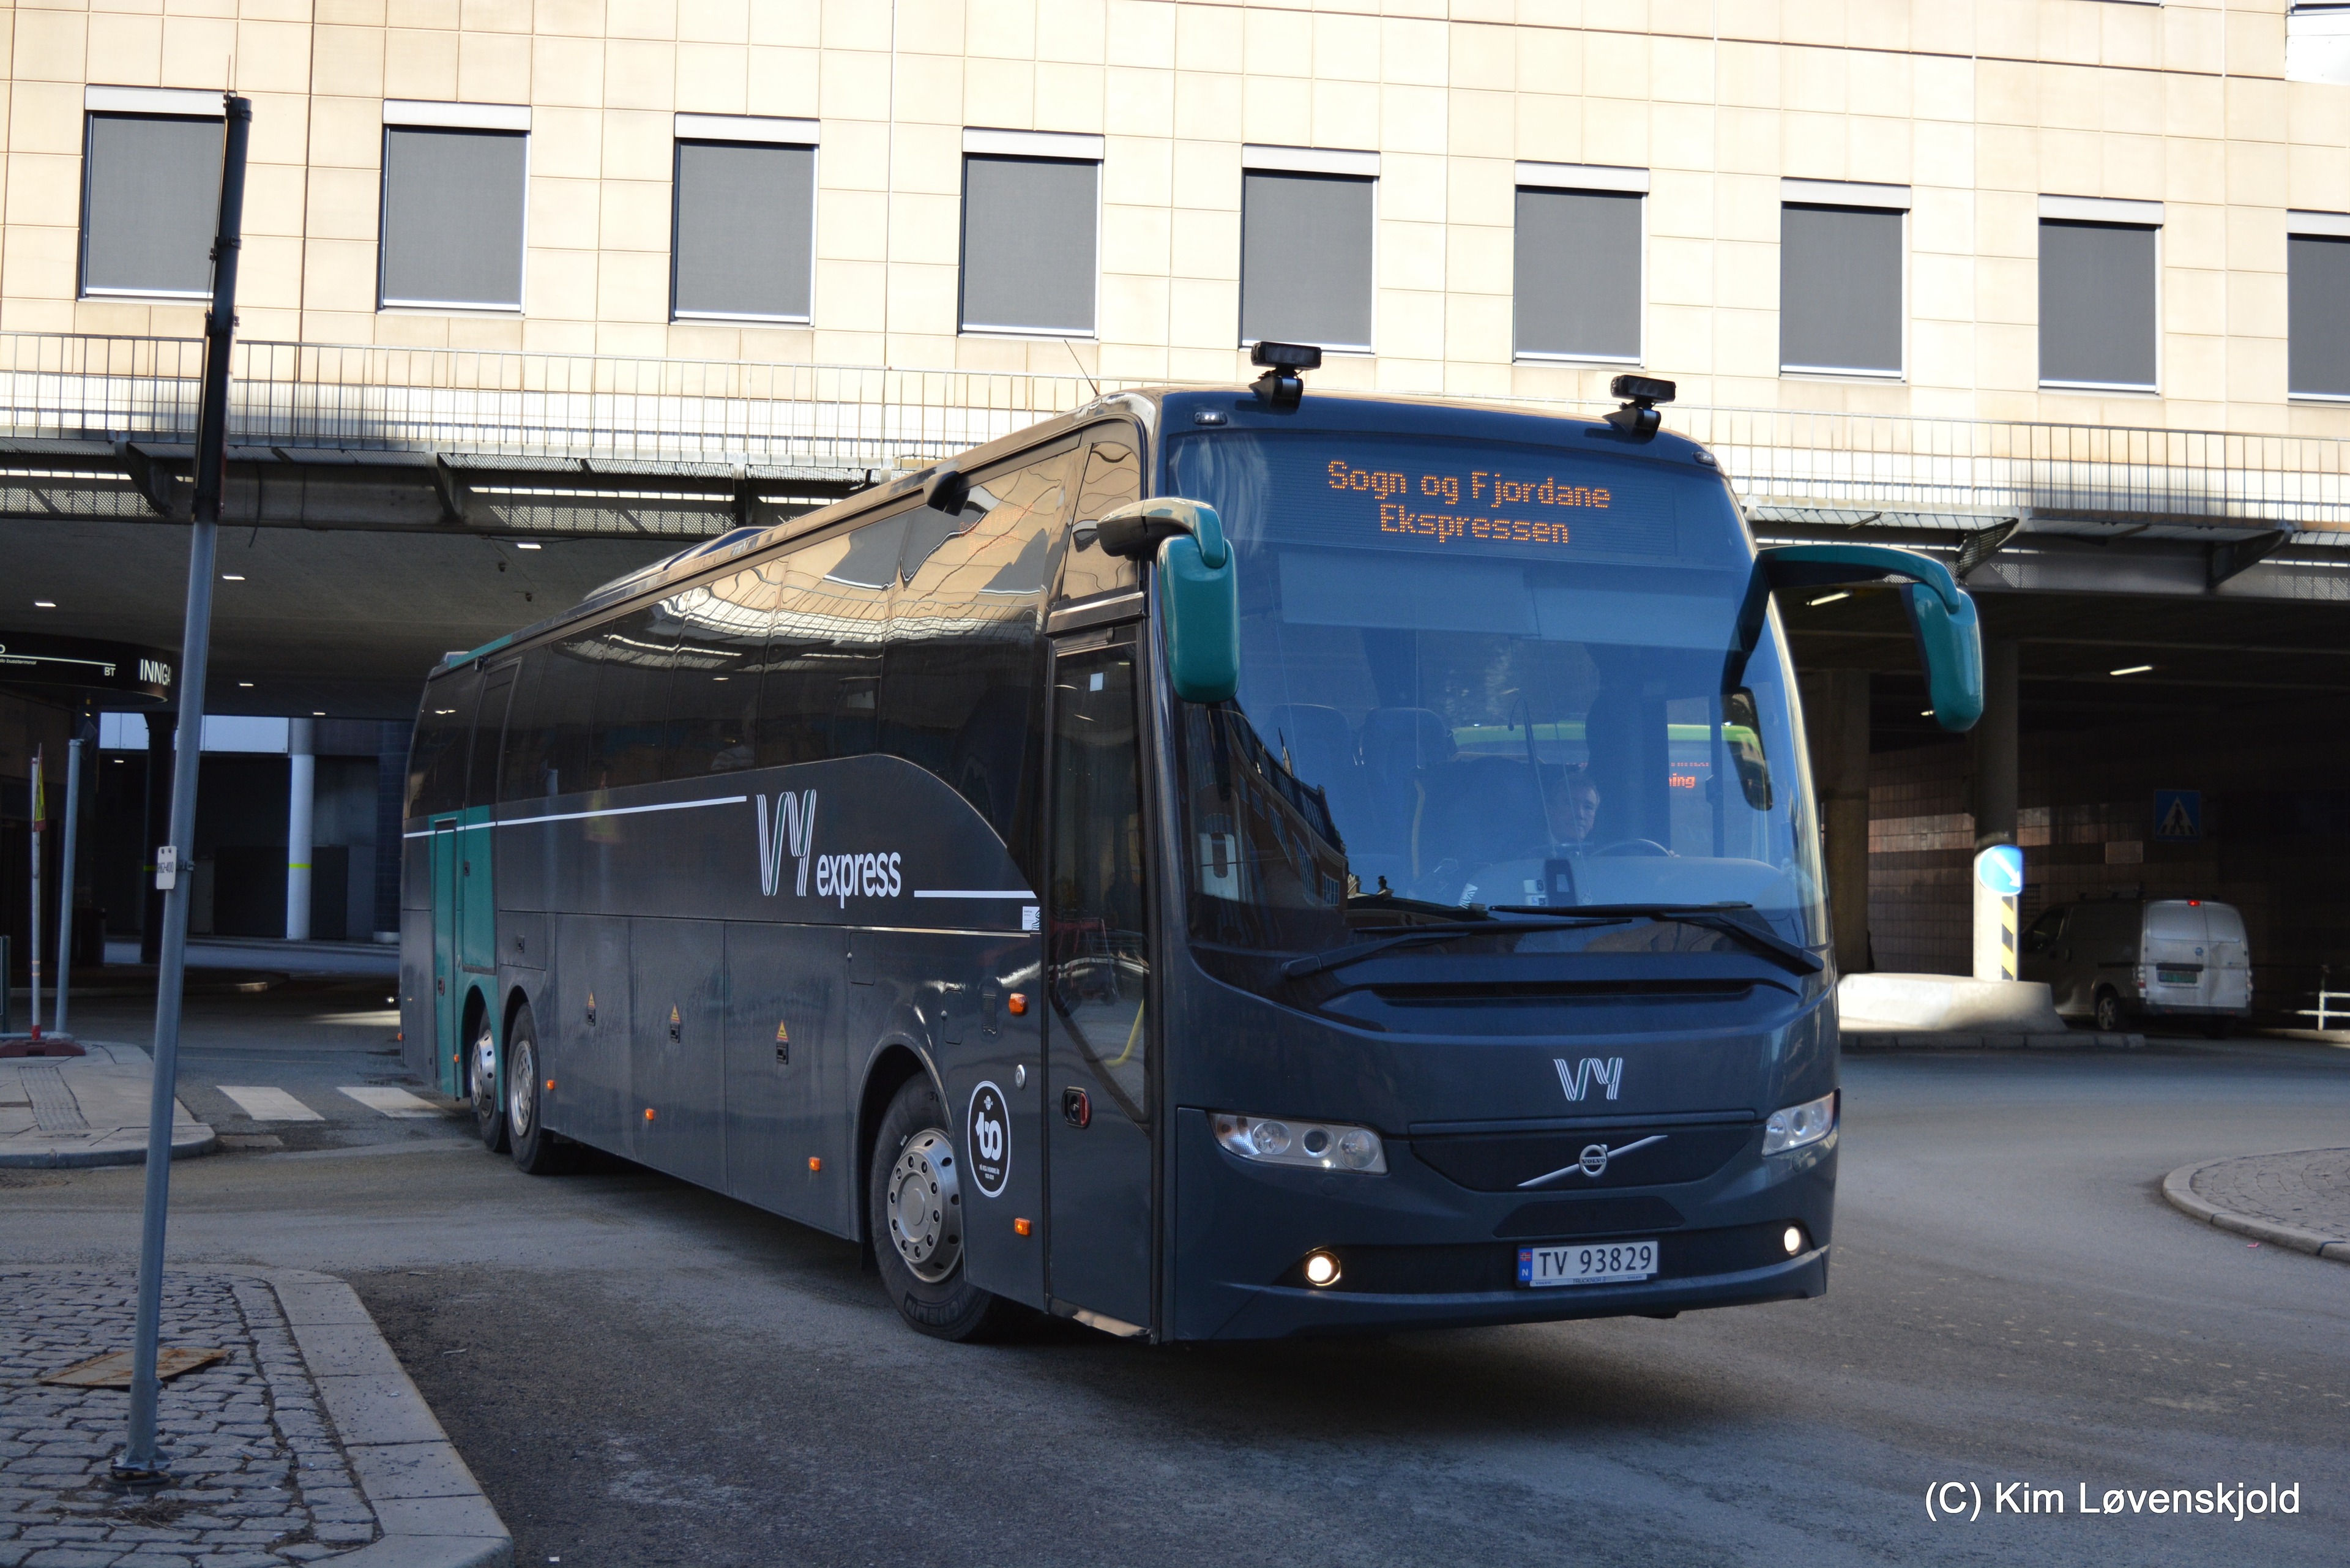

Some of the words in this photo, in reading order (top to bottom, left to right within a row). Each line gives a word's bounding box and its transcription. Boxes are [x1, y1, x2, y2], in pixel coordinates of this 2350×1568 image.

[1328, 461, 1406, 499] Sogn
[1421, 475, 1459, 505] og
[1472, 471, 1611, 507] Fjordane
[1380, 504, 1569, 543] Ekspressen
[105, 667, 116, 677] BT
[816, 851, 901, 909] express
[1539, 1251, 1568, 1276] TV
[1580, 1245, 1652, 1274] 93829
